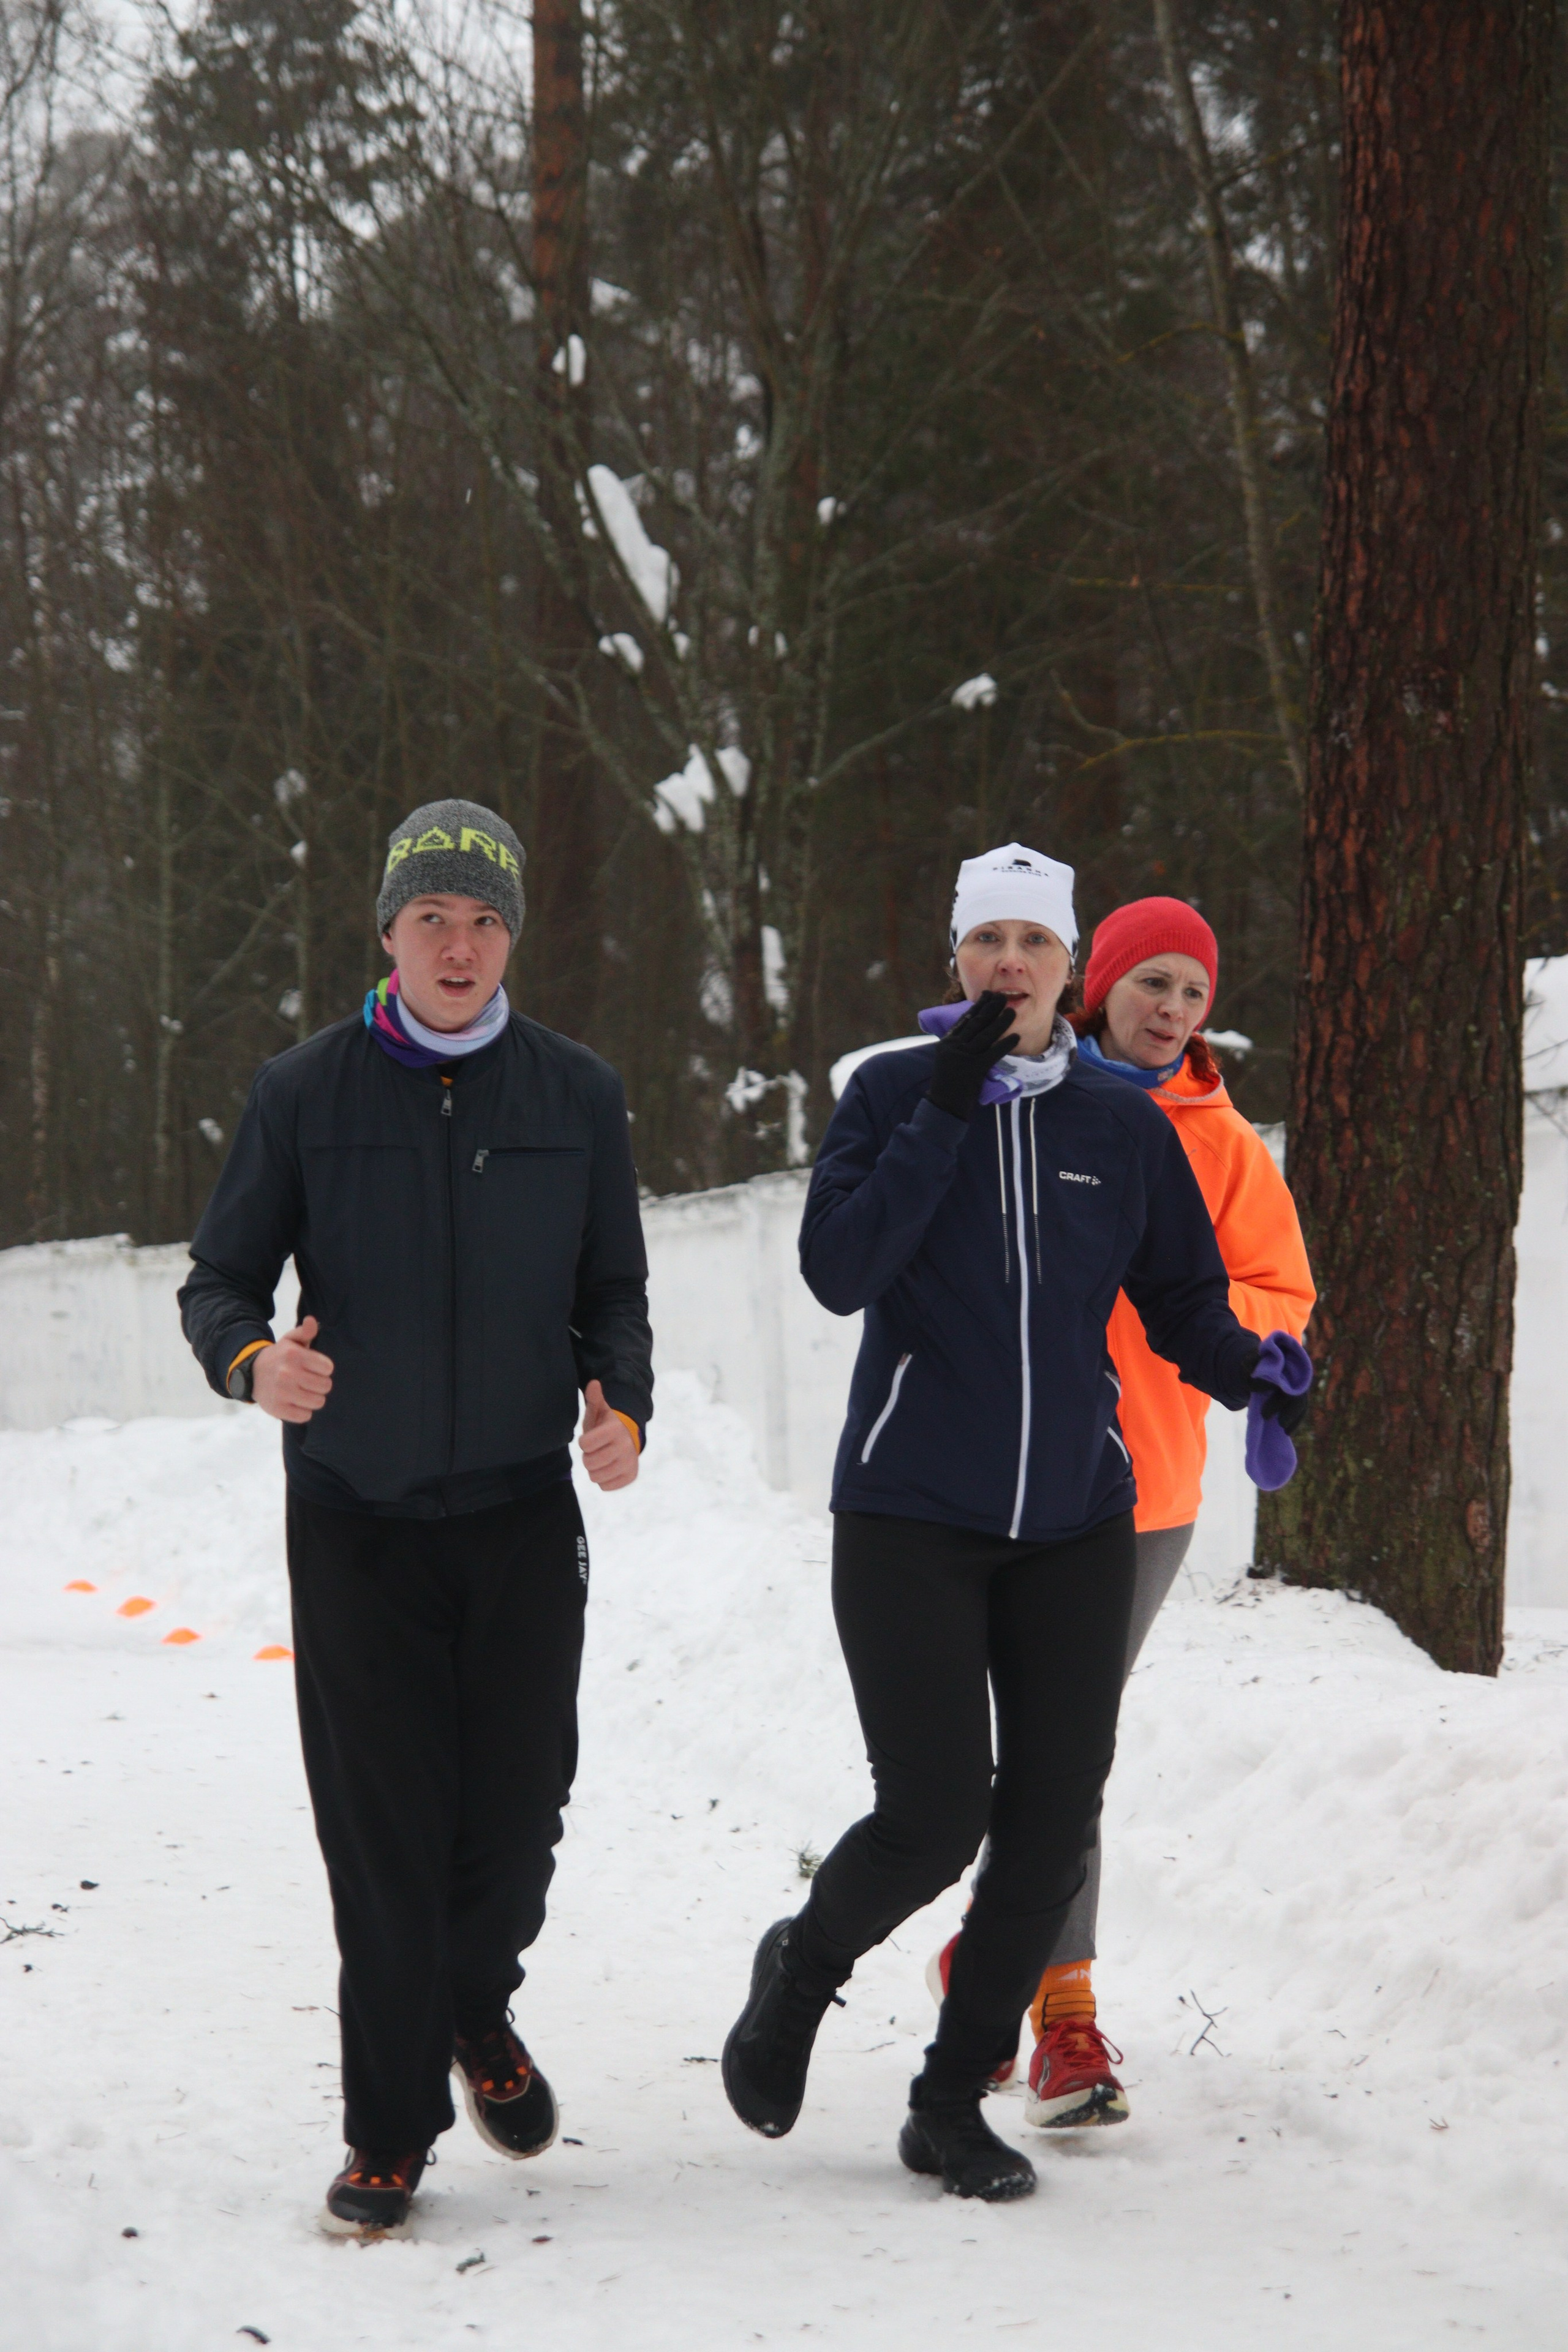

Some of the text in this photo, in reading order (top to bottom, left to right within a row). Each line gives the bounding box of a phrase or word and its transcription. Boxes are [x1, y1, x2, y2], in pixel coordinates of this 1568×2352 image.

[1058, 1170, 1091, 1183] CRAFT
[576, 1535, 588, 1579] GEE JAY
